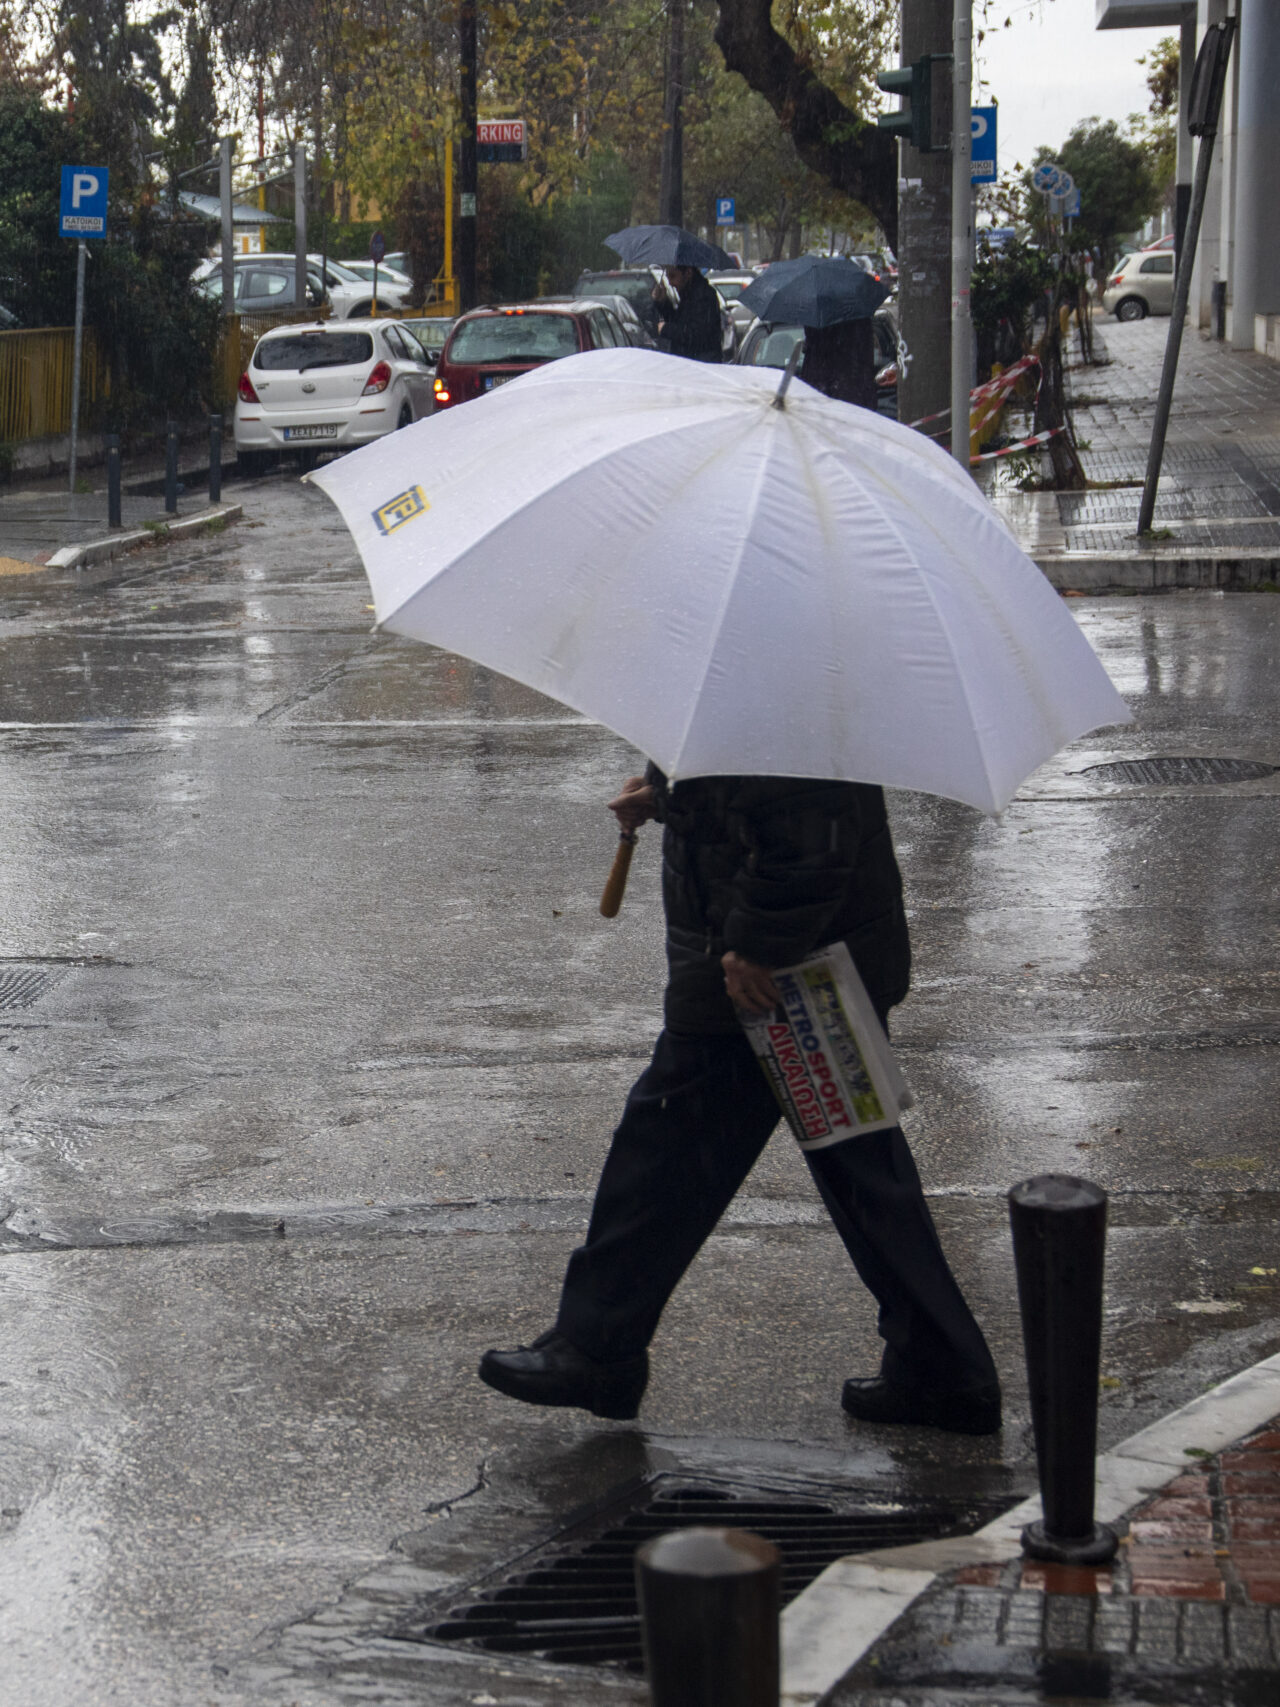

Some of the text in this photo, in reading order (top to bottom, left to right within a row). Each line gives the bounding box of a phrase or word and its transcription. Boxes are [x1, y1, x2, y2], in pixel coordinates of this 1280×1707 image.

[477, 125, 522, 142] RKING
[969, 161, 992, 169] ΟΙΚΟΙ
[72, 173, 99, 208] P
[721, 201, 732, 216] P
[774, 974, 853, 1128] METROSPORT
[767, 1023, 830, 1138] ΔΙΚΑΙΩΣΗ
